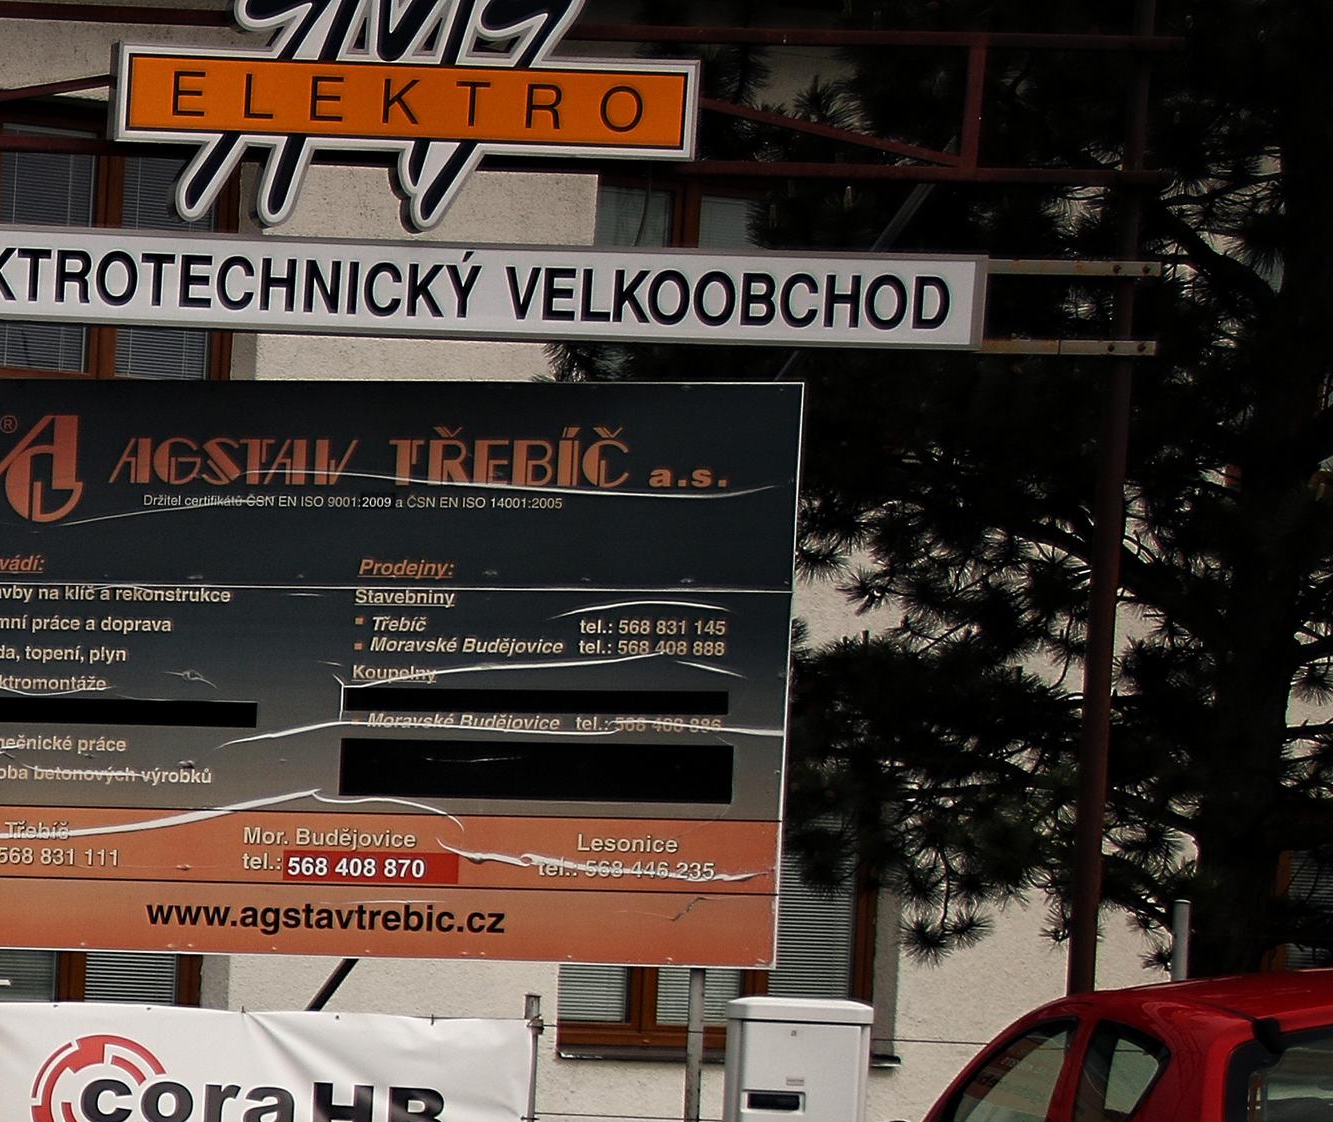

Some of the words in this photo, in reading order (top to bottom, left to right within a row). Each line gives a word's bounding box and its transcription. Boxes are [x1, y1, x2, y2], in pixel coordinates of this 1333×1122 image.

[171, 69, 645, 134] ELEKTRO
[507, 264, 953, 331] VELKOOBCHOD
[109, 437, 359, 487] AGSTAV
[388, 426, 630, 488] TŘEBÍČ
[649, 466, 729, 488] a.s.
[143, 493, 182, 506] Držitel
[279, 495, 297, 507] EN
[301, 495, 324, 508] ISO
[327, 495, 392, 508] 9001:2009
[395, 498, 403, 508] a
[406, 495, 436, 508] ČSN
[440, 497, 459, 508] EN
[463, 497, 486, 509] ISO
[490, 497, 563, 510] 14001:2005
[358, 558, 455, 578] Prodejny:
[38, 588, 59, 601] na
[65, 585, 95, 601] klíč
[100, 589, 110, 601] a
[116, 586, 231, 602] rekonstrukce
[355, 588, 455, 607] Stavebniny
[32, 615, 81, 634] práce
[86, 619, 95, 631] a
[100, 616, 172, 635] doprava
[371, 614, 427, 632] Třebíč
[580, 617, 614, 635] tel.:
[618, 619, 650, 635] 568
[656, 619, 687, 635] 831
[694, 620, 726, 636] 145
[25, 645, 84, 664] topení,
[89, 646, 127, 665] plyn
[369, 635, 457, 655] Moravské
[462, 636, 564, 658] Budějovice
[578, 638, 613, 655] tel.:
[617, 639, 650, 656] 568
[655, 640, 687, 656] 408
[694, 640, 725, 657] 888
[460, 713, 561, 732] Budějovice
[575, 716, 609, 731] tel.:
[77, 736, 127, 754] práce
[141, 767, 212, 786] výrobků
[243, 826, 290, 846] Mor.
[295, 827, 417, 851] Budějovice
[577, 833, 678, 853] Lesonice
[40, 848, 75, 866] 831
[84, 849, 119, 866] 111
[242, 854, 282, 872] tel.:
[286, 855, 328, 876] 568
[335, 857, 376, 877] 408
[383, 858, 426, 879] 870
[585, 860, 624, 878] 568
[676, 862, 715, 880] 235
[146, 903, 506, 936] www.agstavtrebic.cz
